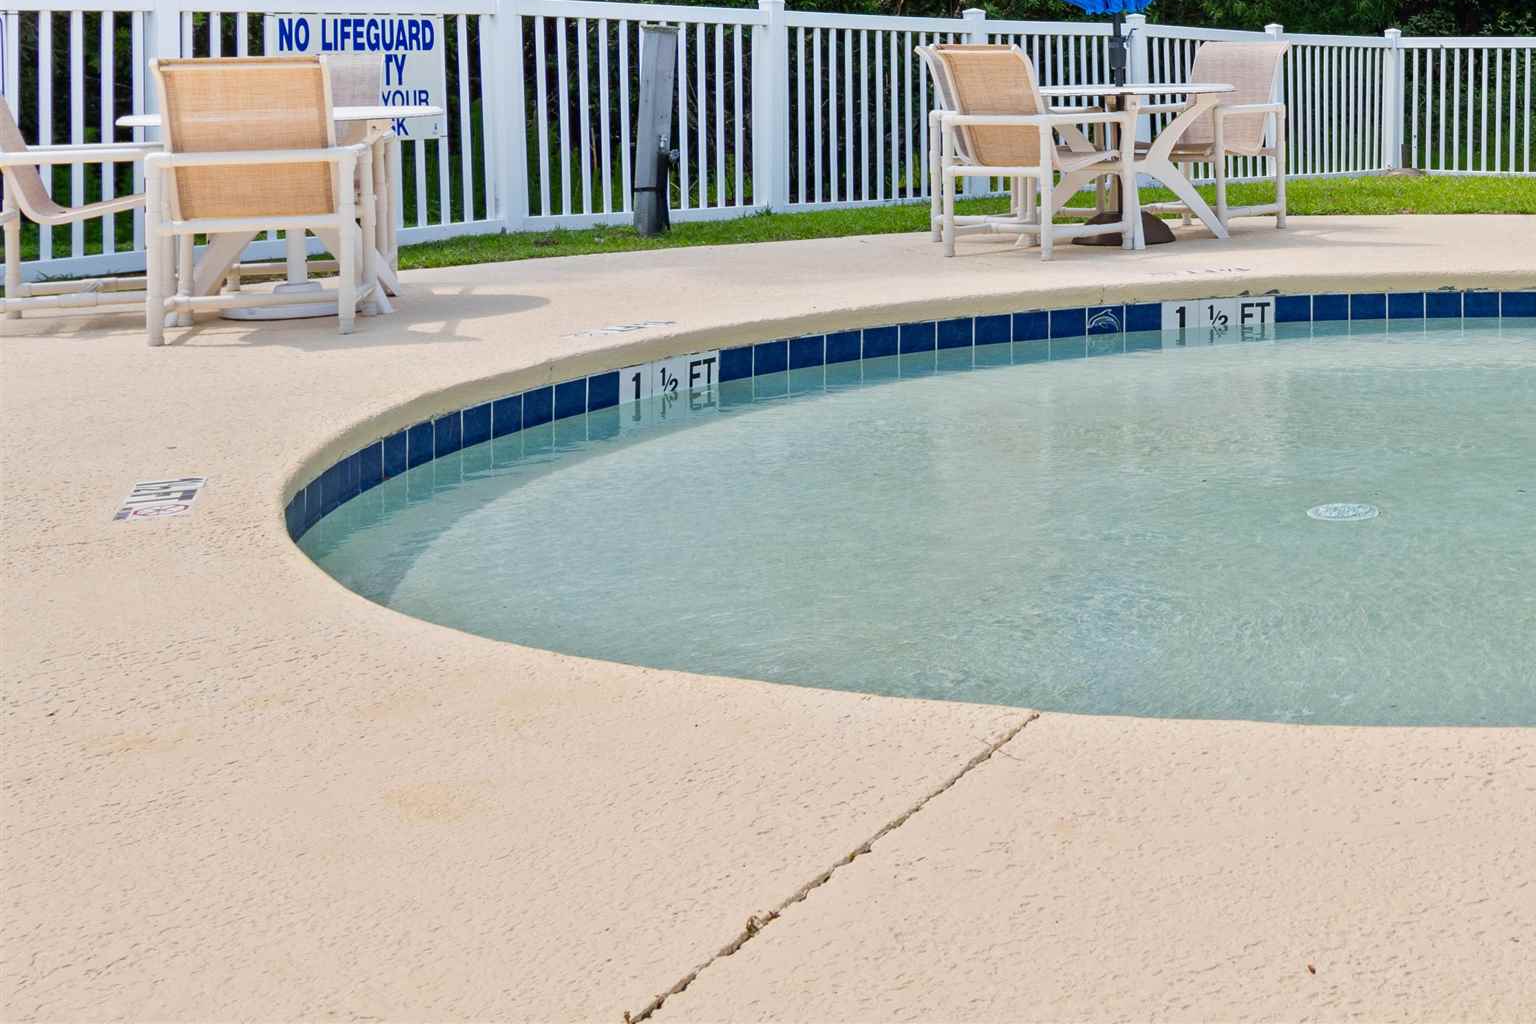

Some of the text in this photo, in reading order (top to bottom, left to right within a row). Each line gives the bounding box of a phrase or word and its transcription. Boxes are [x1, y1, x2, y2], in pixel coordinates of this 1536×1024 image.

[278, 17, 435, 52] NO LIFEGUARD
[1175, 306, 1186, 328] 1
[1240, 301, 1271, 324] FT
[631, 372, 641, 400] 1
[689, 357, 716, 388] FT
